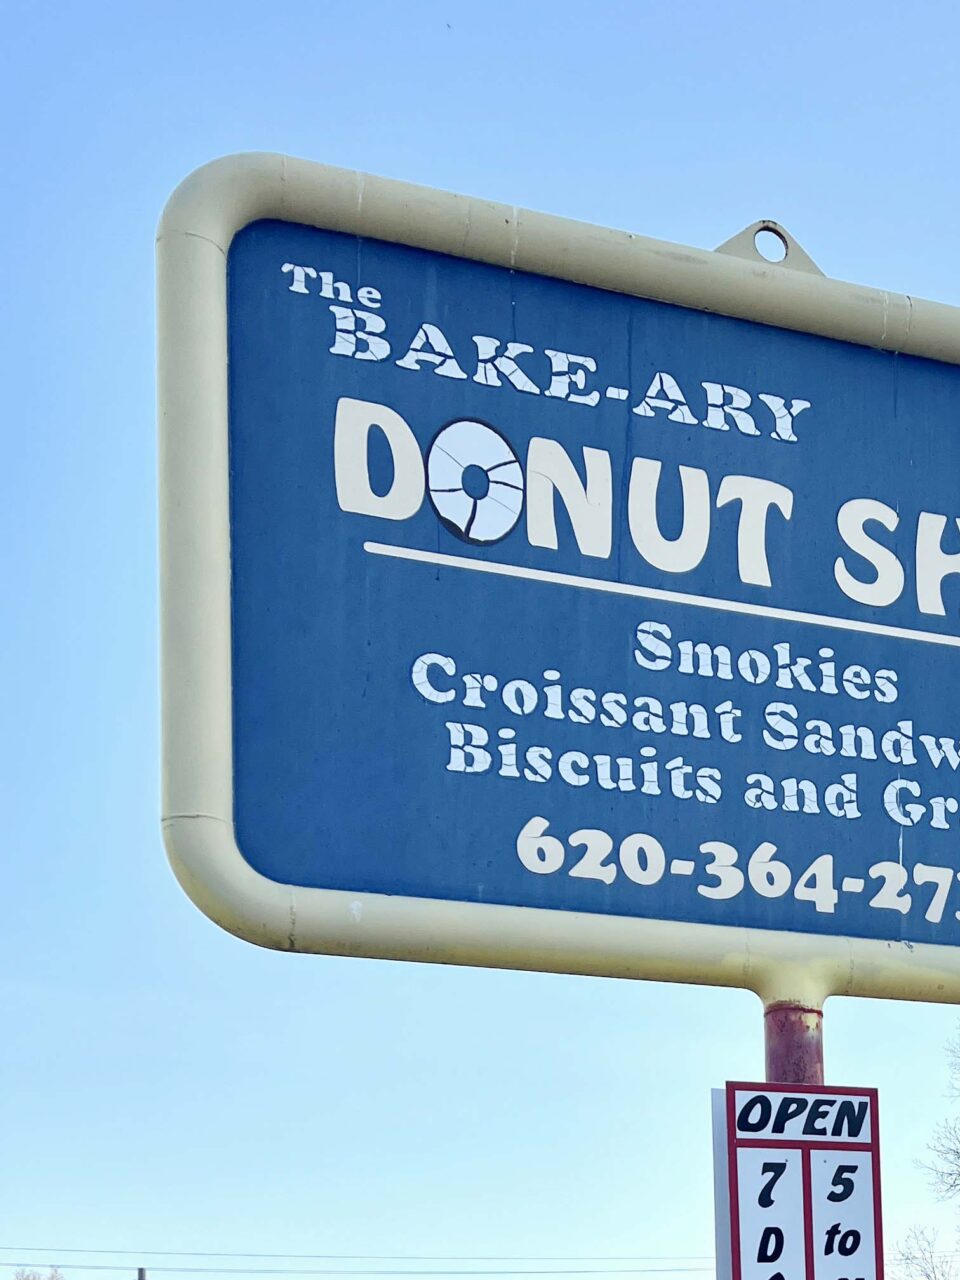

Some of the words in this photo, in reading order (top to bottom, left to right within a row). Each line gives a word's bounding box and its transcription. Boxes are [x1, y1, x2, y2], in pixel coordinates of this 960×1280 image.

[281, 262, 382, 308] The
[328, 304, 812, 443] BAKE-ARY
[333, 396, 795, 588] DONUT
[634, 620, 899, 704] Smokies
[411, 652, 743, 744] Croissant
[444, 721, 723, 804] Biscuits
[744, 772, 862, 820] and
[736, 1094, 869, 1138] OPEN
[757, 1162, 788, 1209] 7
[826, 1164, 859, 1203] 5
[823, 1222, 862, 1257] to
